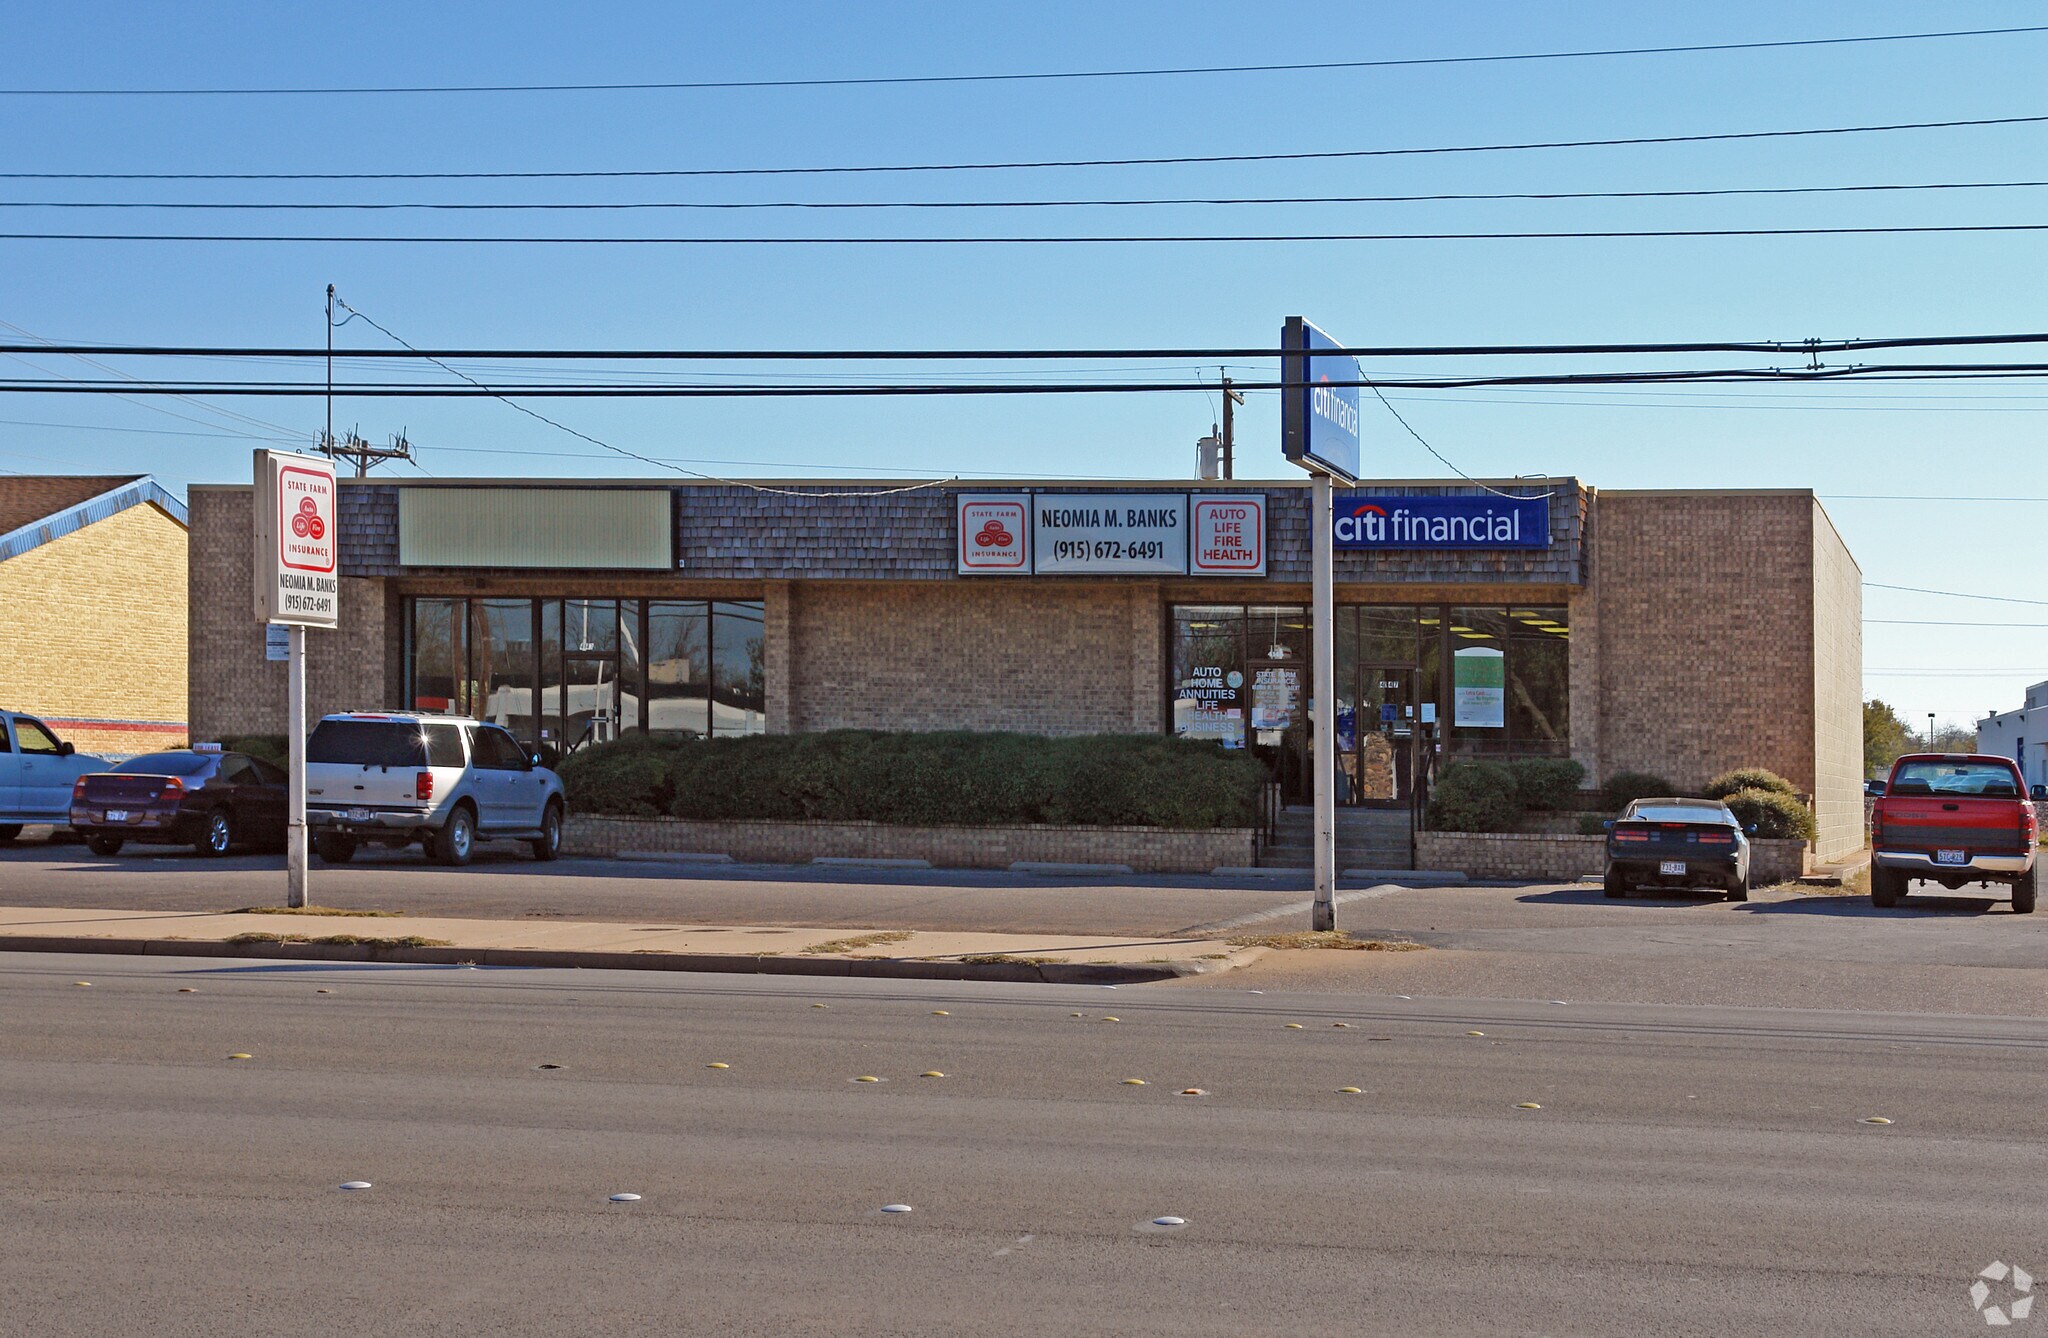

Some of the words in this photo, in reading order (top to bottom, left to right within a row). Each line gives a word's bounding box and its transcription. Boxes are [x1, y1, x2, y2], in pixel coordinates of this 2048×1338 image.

[287, 480, 307, 492] STATE
[309, 484, 328, 495] FARM
[1041, 509, 1101, 528] NEOMIA
[1104, 509, 1123, 528] M.
[1126, 509, 1178, 528] BANKS
[1209, 509, 1246, 520] AUTO
[297, 521, 306, 531] Life
[1214, 522, 1241, 533] LIFE
[1334, 509, 1386, 541] citi
[1391, 508, 1520, 542] financial
[1214, 535, 1242, 547] FIRE
[288, 544, 329, 557] INSURANCE
[1053, 540, 1091, 562] (915)
[1094, 541, 1164, 559] 672-6491
[1203, 549, 1253, 560] HEALTH
[279, 573, 306, 590] NEOMIA
[307, 577, 316, 591] M.
[316, 578, 337, 593] BANKS
[284, 594, 302, 612] (915)
[302, 596, 331, 612] 672-6491
[1192, 667, 1222, 677] AUTO
[1190, 678, 1223, 688] HOME
[1179, 689, 1236, 699] ANNUITIES
[1196, 700, 1219, 710] LIFE
[1187, 711, 1228, 721] HEALTH
[1180, 722, 1235, 732] BUSINESS
